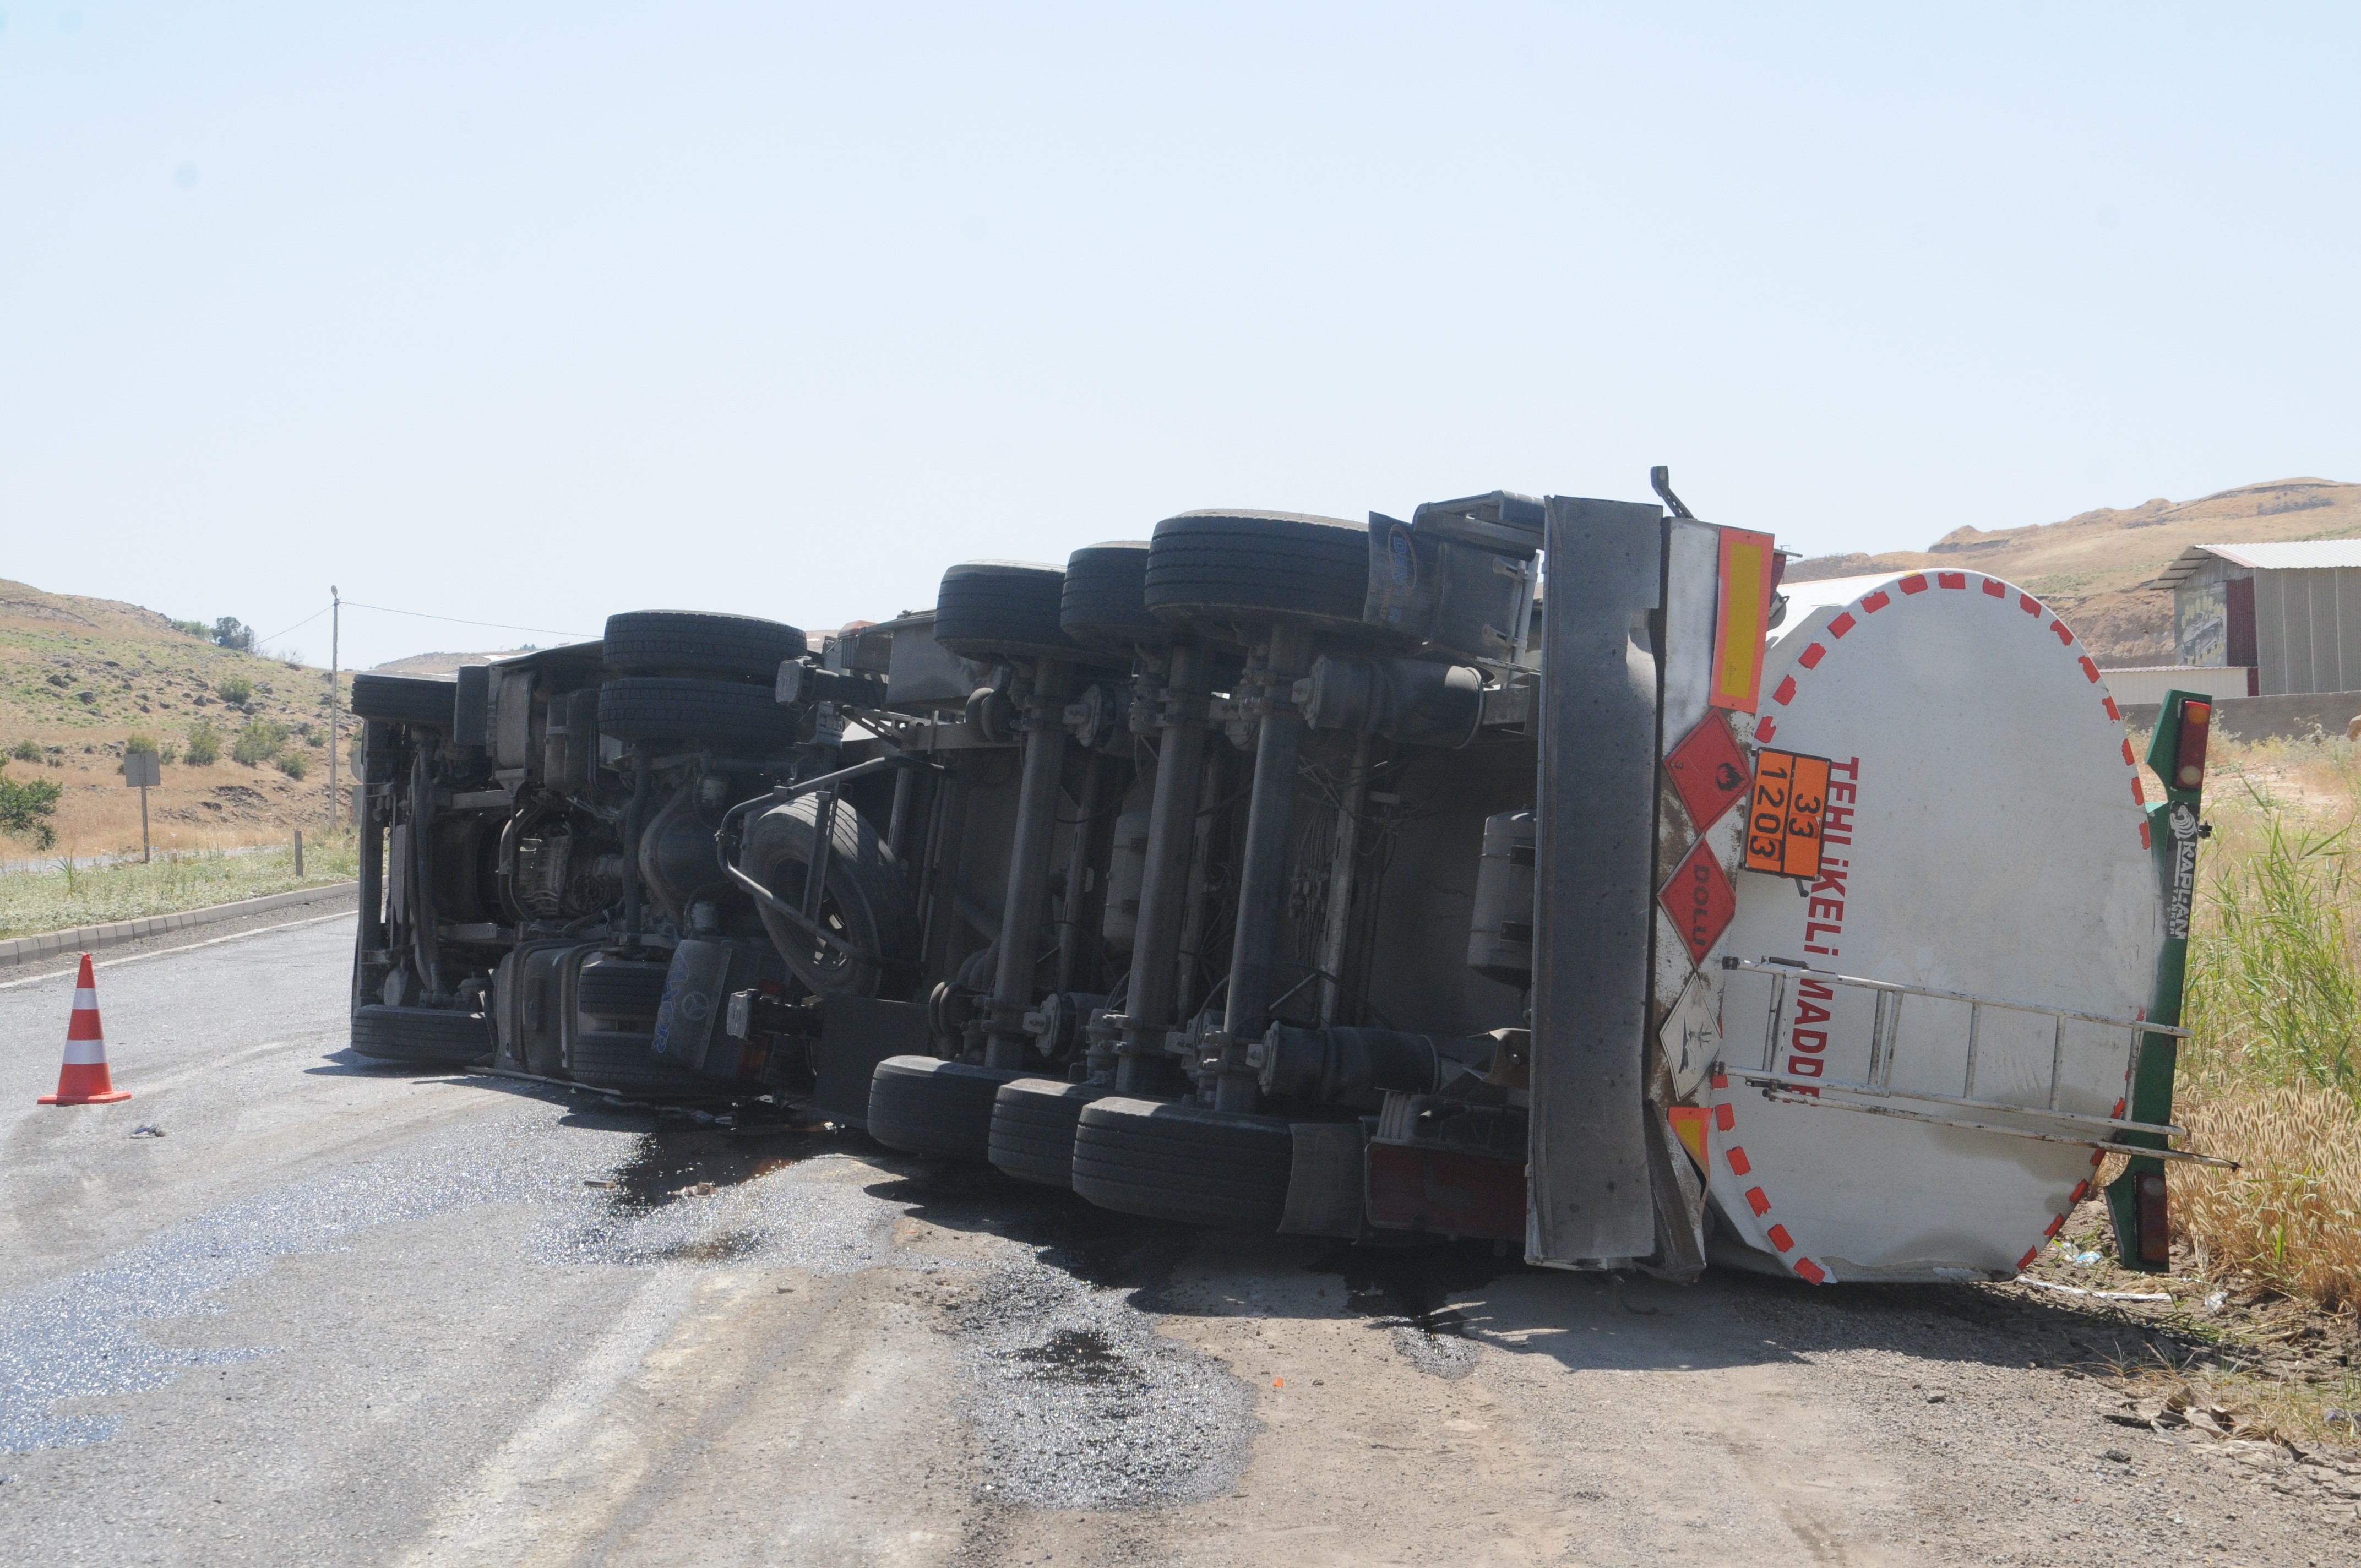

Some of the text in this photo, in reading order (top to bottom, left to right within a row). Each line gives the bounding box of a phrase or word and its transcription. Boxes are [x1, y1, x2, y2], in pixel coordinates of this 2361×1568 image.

[1749, 766, 1788, 858] 1203
[1789, 793, 1822, 839] 33
[1692, 865, 1710, 945] DOLU
[2170, 889, 2178, 935] TANKER
[2174, 840, 2196, 940] KAPLAN
